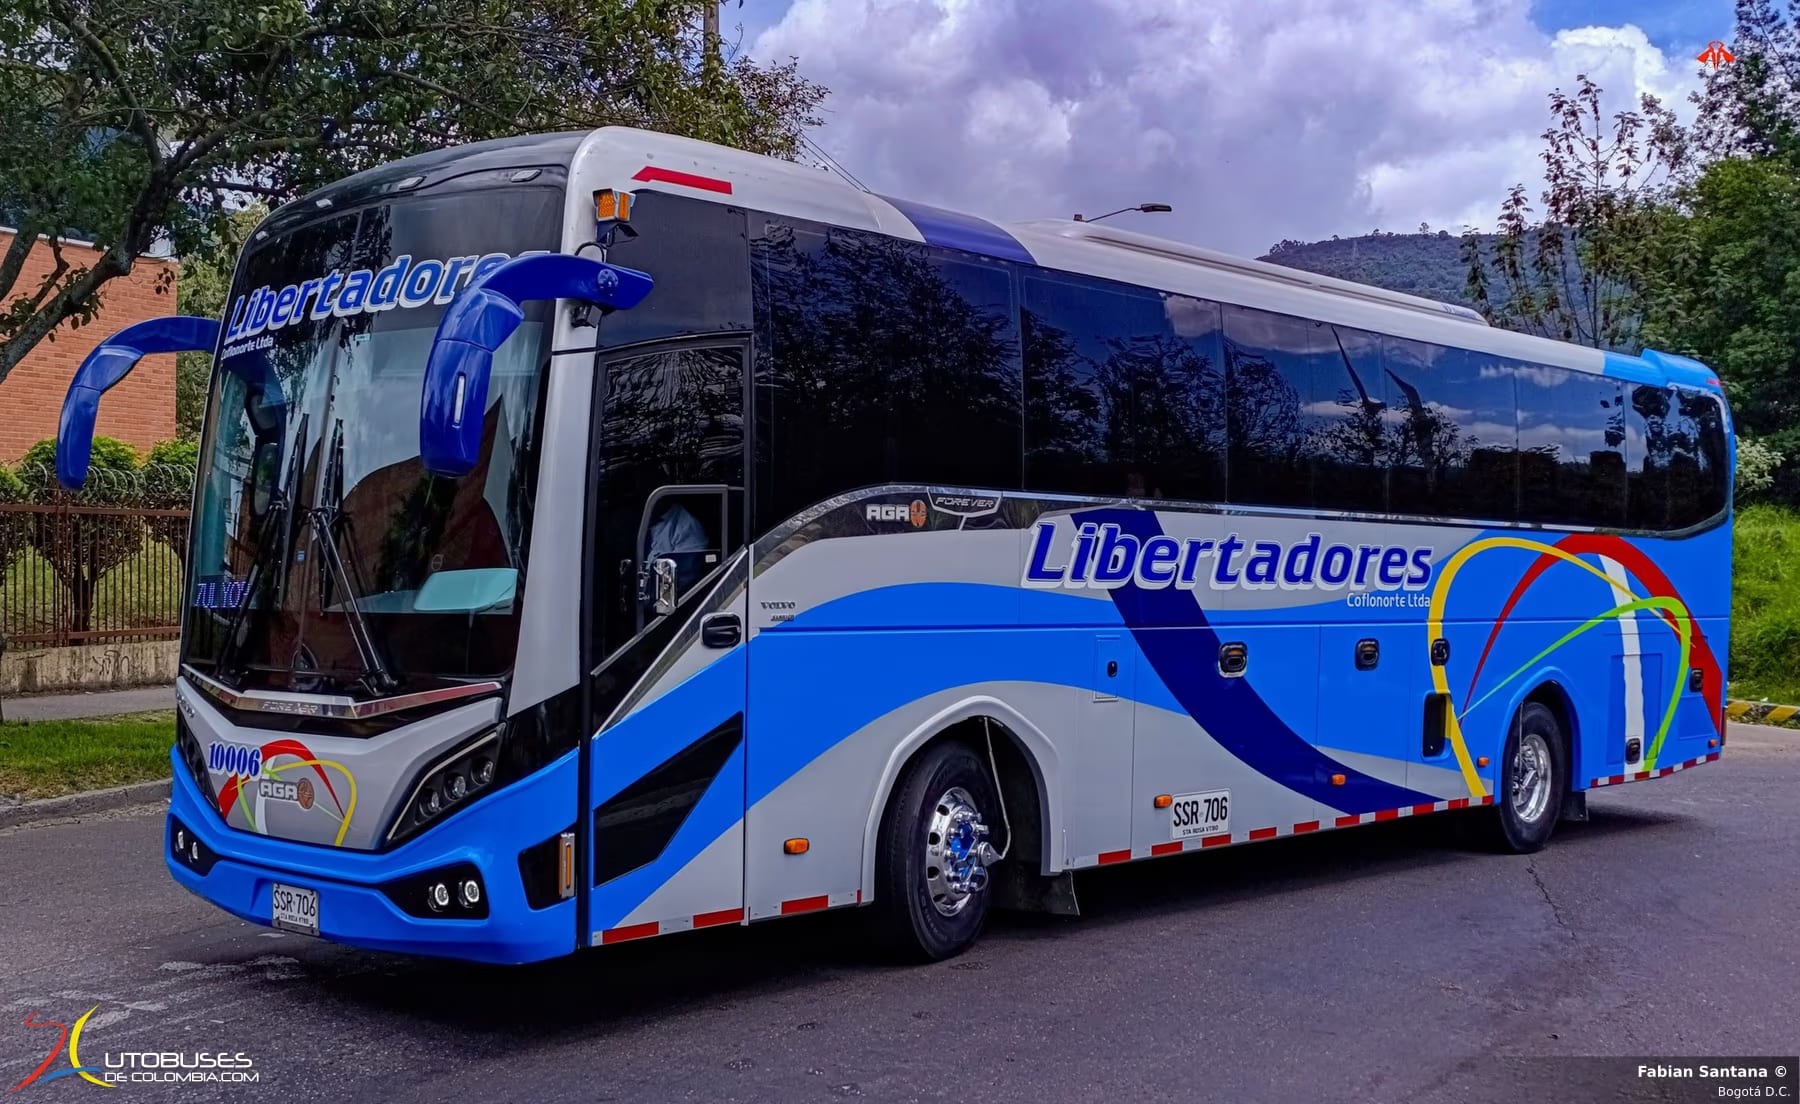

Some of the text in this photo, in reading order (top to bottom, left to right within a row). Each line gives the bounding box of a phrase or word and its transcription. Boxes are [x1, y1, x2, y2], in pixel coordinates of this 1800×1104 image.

[256, 335, 274, 350] Ltda
[935, 497, 994, 508] FOREVER
[866, 504, 910, 521] AGA
[1020, 520, 1434, 590] Libertadores
[760, 601, 796, 610] VOLVO
[1347, 592, 1431, 607] Coflonorte Ltda
[207, 741, 262, 779] 10006
[260, 780, 299, 801] AGA
